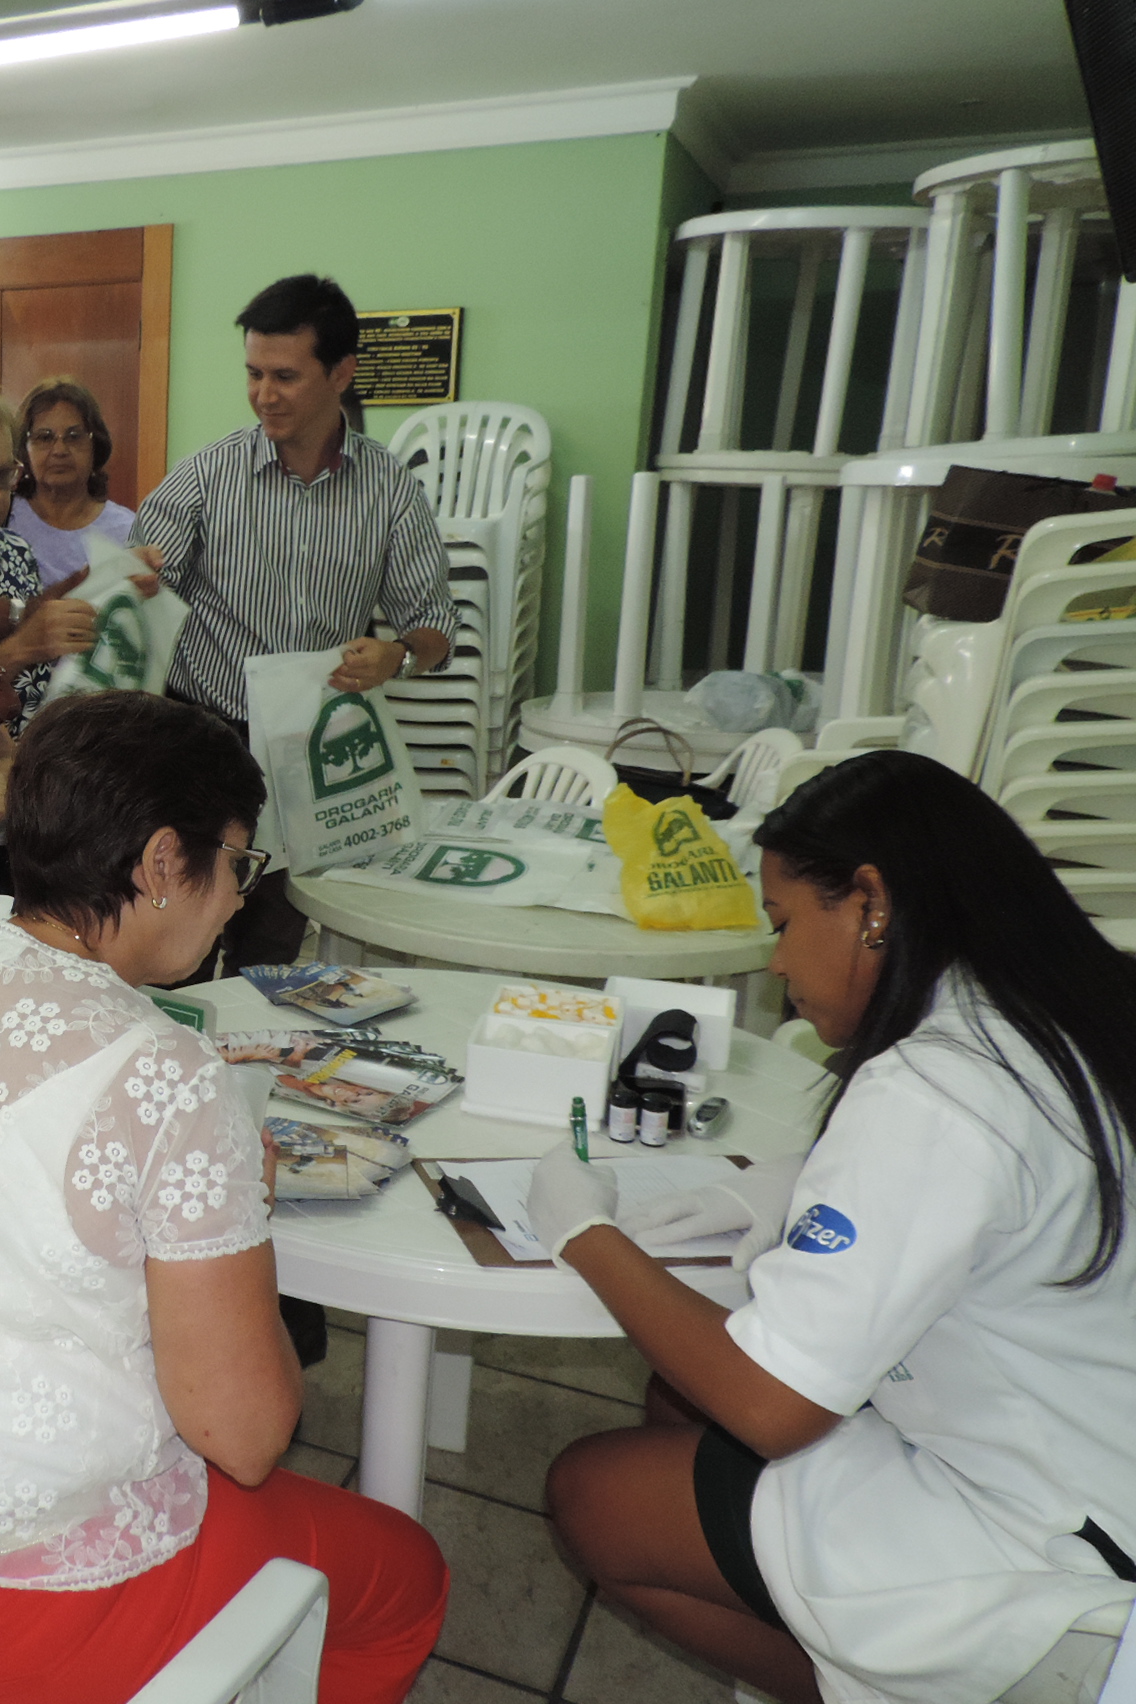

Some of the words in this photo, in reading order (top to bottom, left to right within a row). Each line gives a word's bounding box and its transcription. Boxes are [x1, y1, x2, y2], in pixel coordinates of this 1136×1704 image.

[315, 782, 403, 822] DROGARIA
[325, 795, 399, 829] GALANTI
[344, 815, 411, 847] 4002-3768
[647, 858, 738, 892] GALANTI
